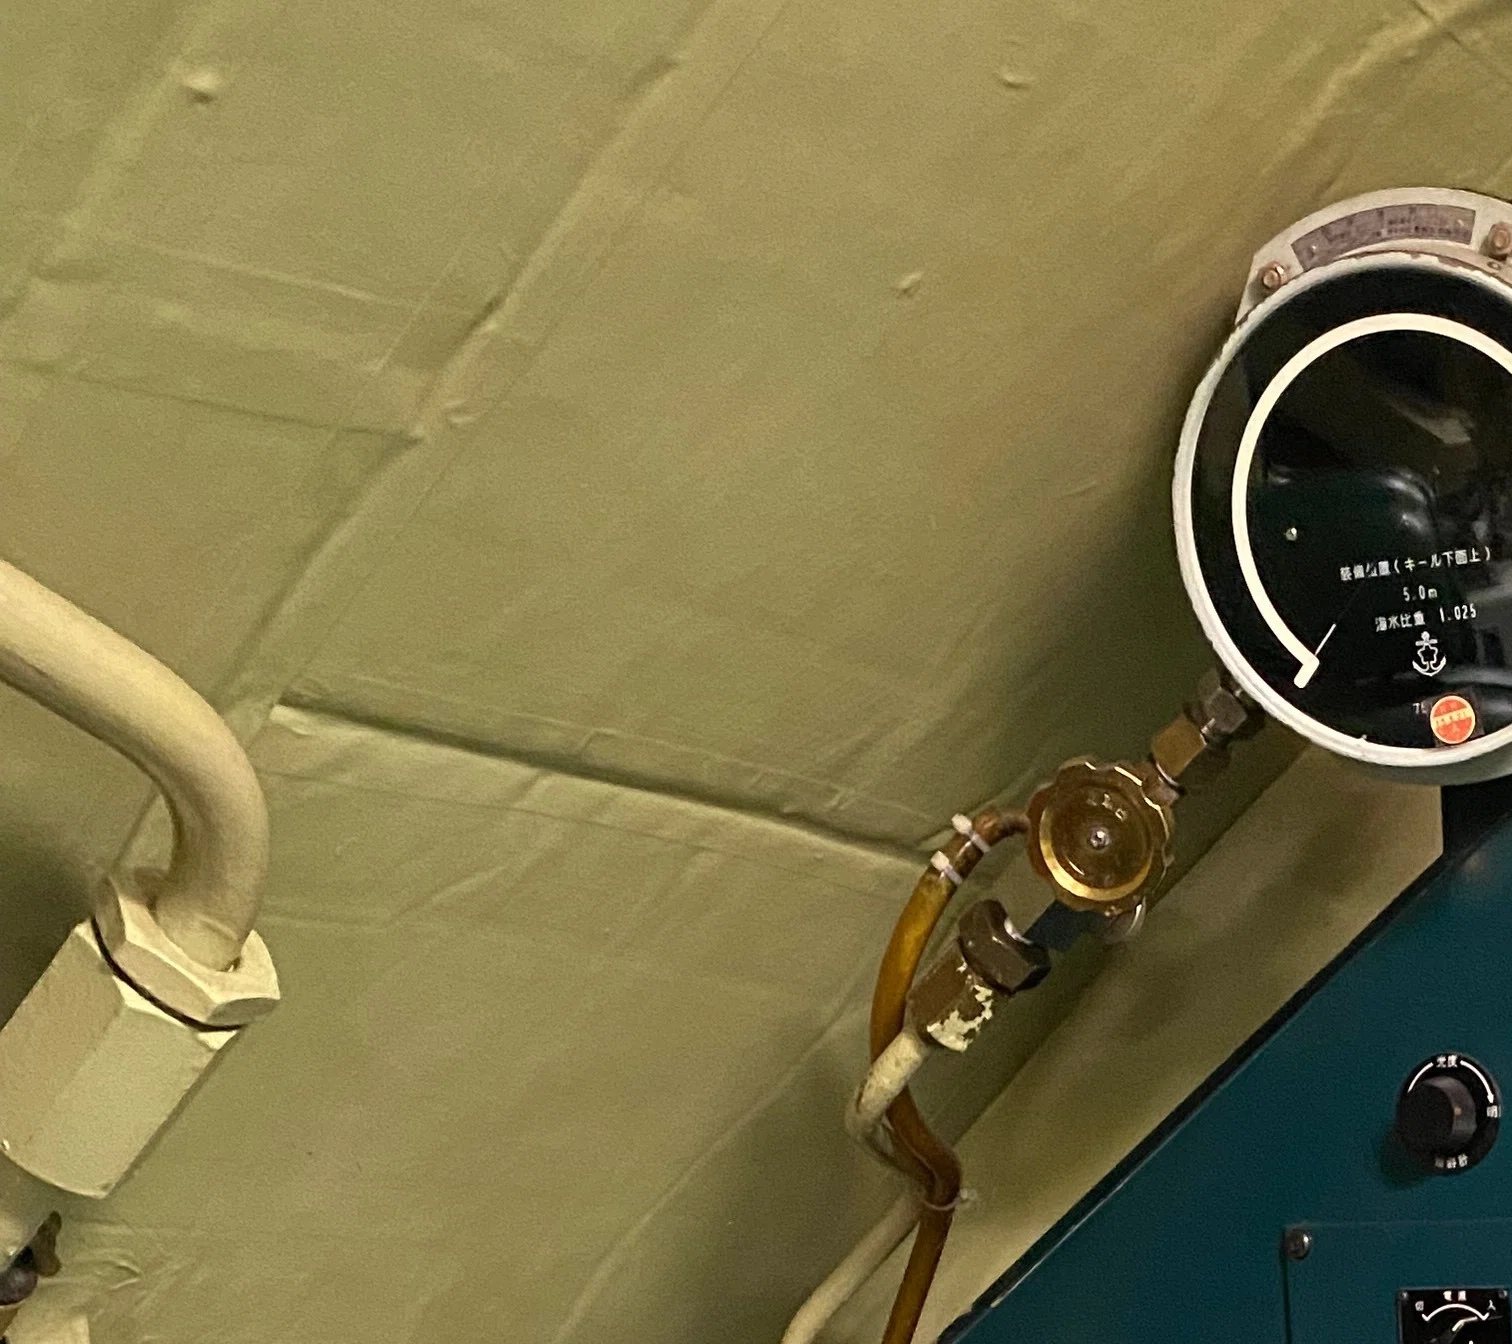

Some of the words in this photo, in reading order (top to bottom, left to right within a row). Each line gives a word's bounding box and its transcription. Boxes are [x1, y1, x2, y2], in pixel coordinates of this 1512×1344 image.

[1403, 585, 1438, 601] 5.0m
[1375, 610, 1426, 632] 海水比重
[1439, 603, 1477, 623] 1.025
